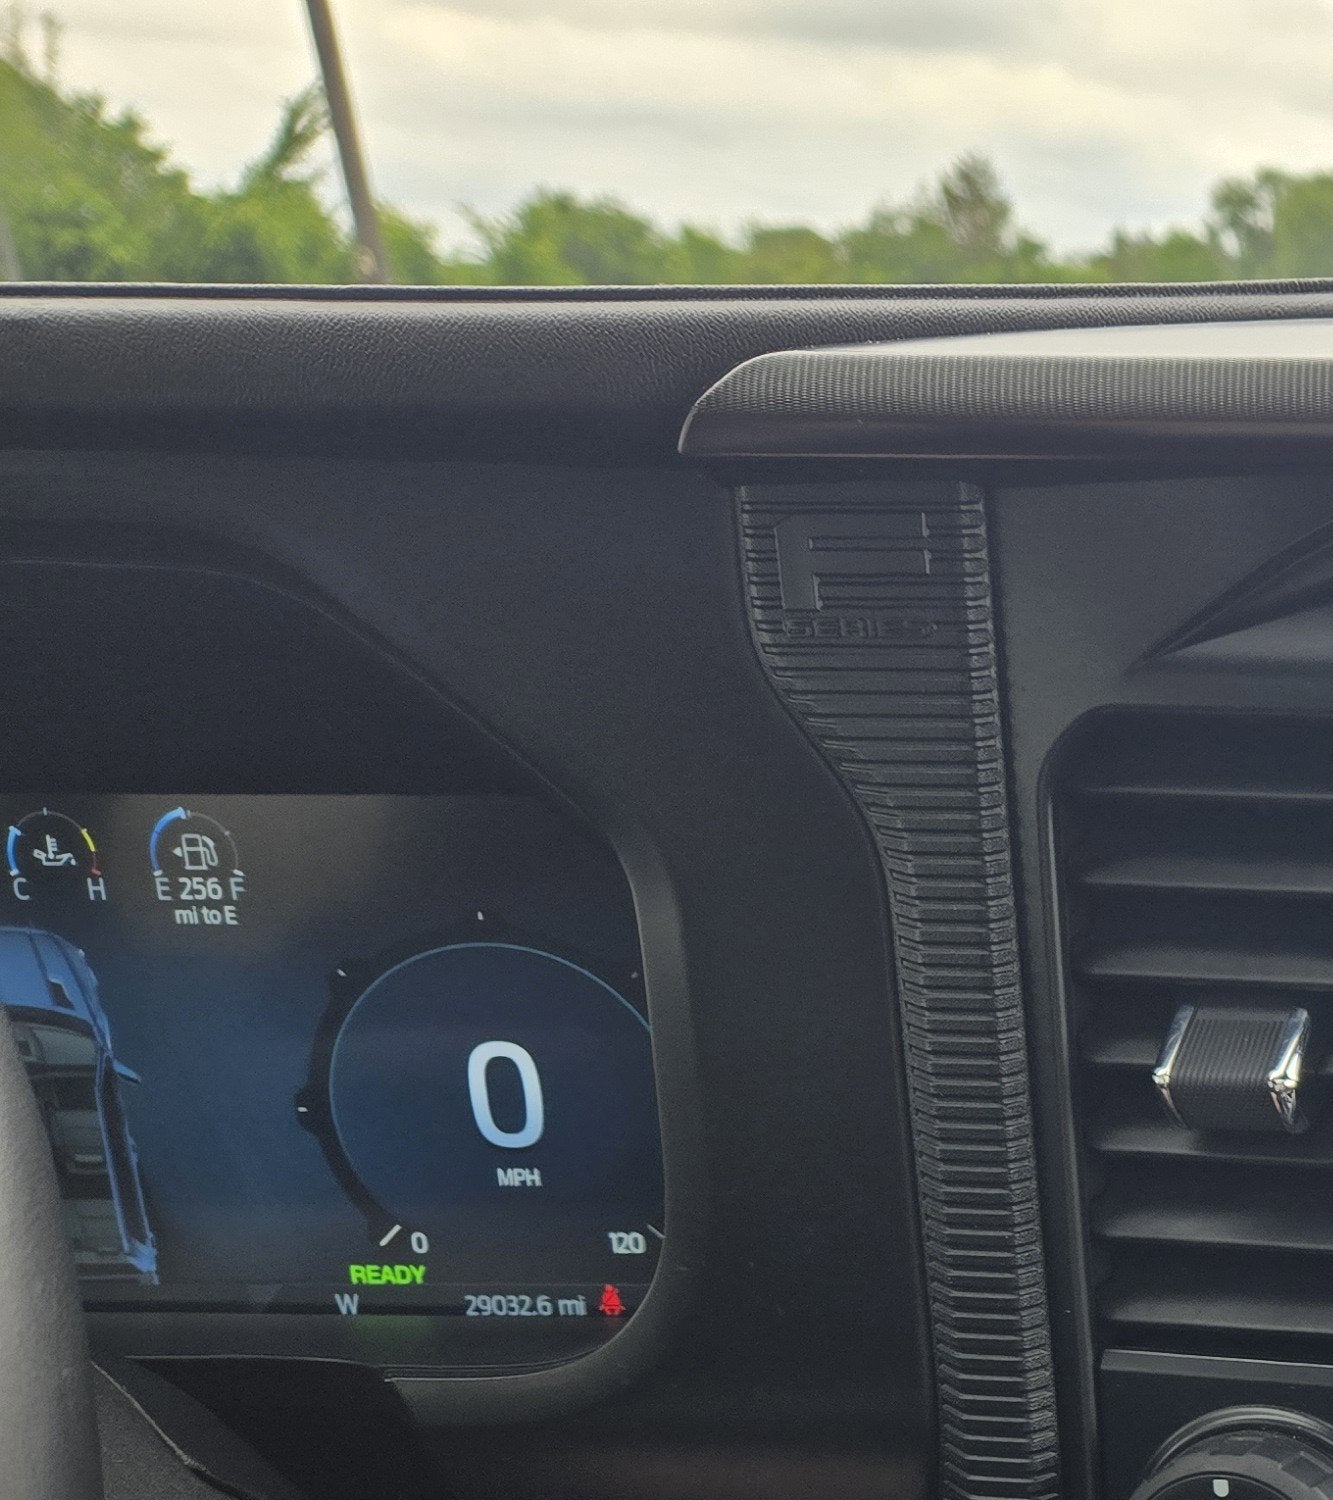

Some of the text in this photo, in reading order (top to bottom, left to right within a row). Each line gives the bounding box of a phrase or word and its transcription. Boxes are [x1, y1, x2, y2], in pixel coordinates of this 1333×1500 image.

[12, 877, 30, 901] C
[87, 876, 106, 900] H
[157, 877, 246, 900] E 256 F
[175, 906, 239, 925] mi to E
[467, 1040, 545, 1148] 0
[497, 1167, 542, 1187] MPH
[411, 1232, 428, 1255] 0
[609, 1232, 646, 1254] 120
[350, 1264, 425, 1285] READY
[334, 1294, 360, 1316] W
[464, 1294, 586, 1317] 29032.6 mi
